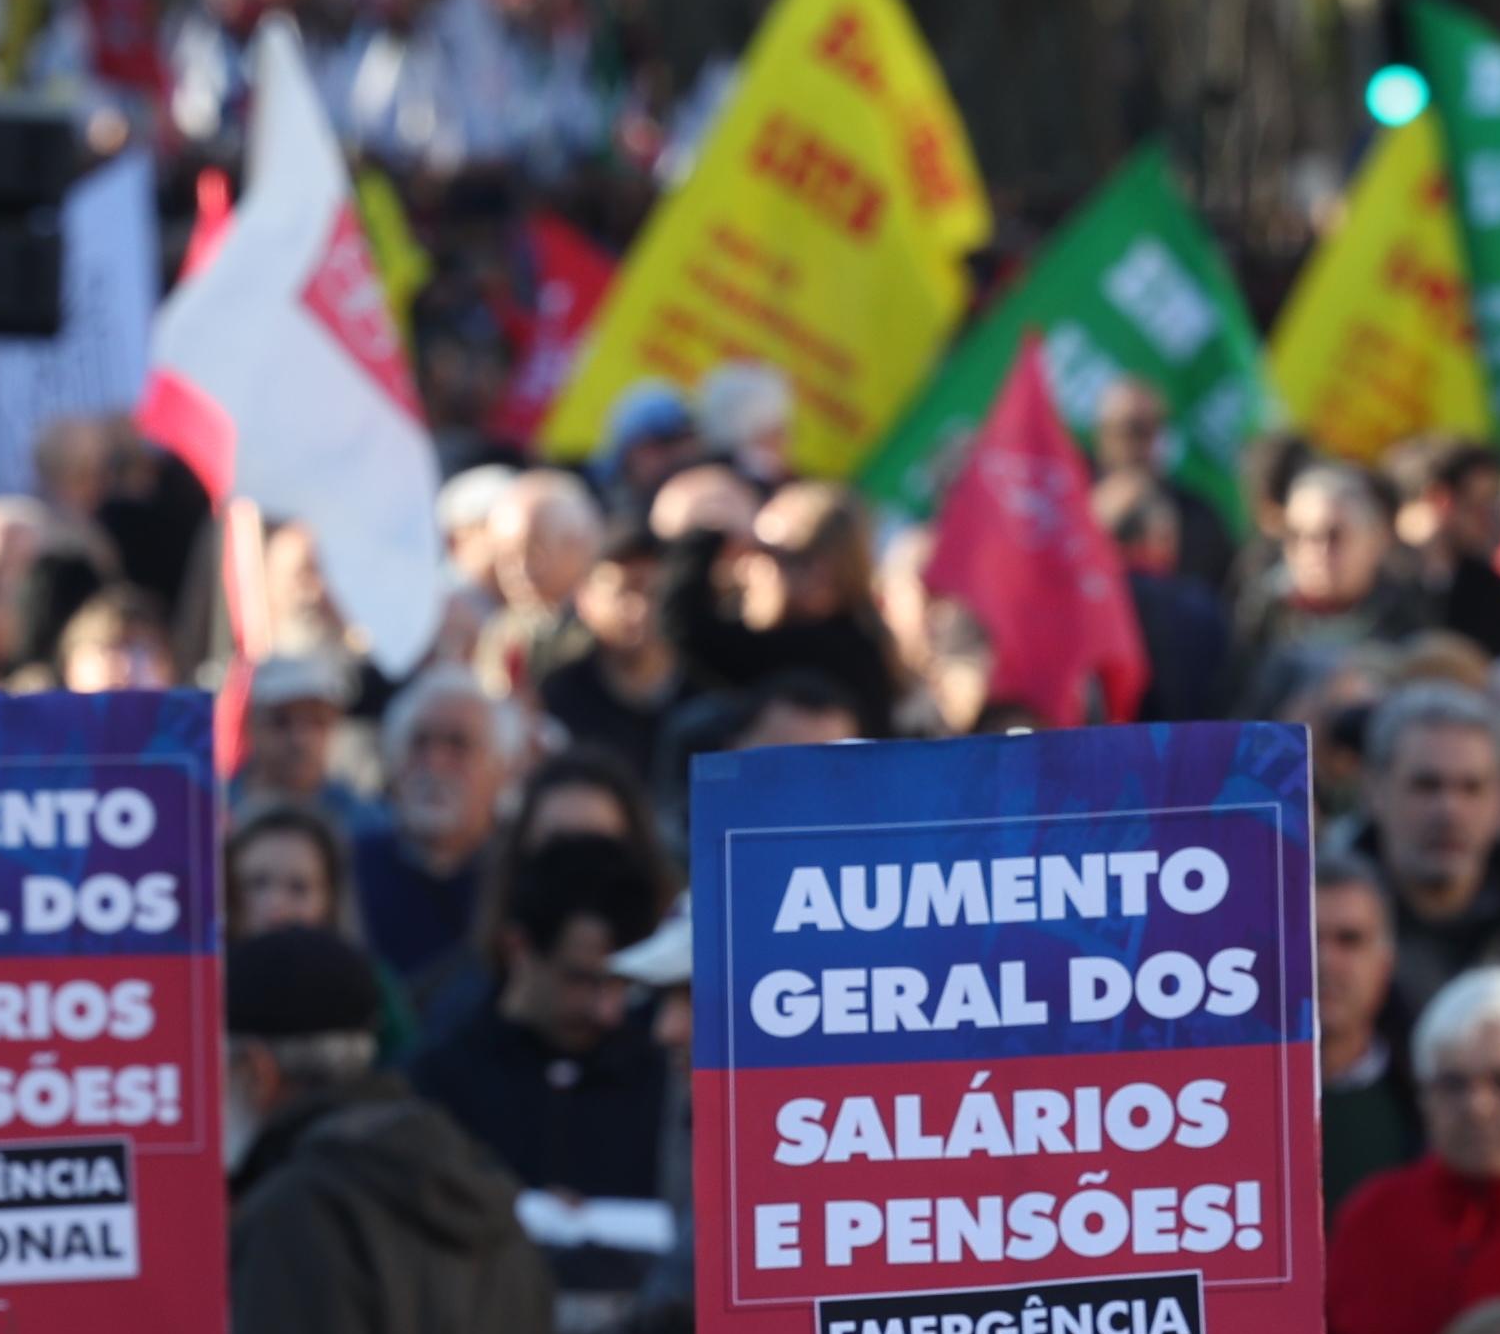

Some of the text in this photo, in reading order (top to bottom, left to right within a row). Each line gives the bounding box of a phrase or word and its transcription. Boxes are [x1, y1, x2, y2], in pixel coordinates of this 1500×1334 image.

[22, 872, 180, 935] DOS
[773, 847, 1229, 933] AUMENTO
[750, 947, 1259, 1038] GERAL DOS
[773, 1071, 1229, 1166] SALÁRIOS
[754, 1170, 1263, 1269] E PENSÕES!
